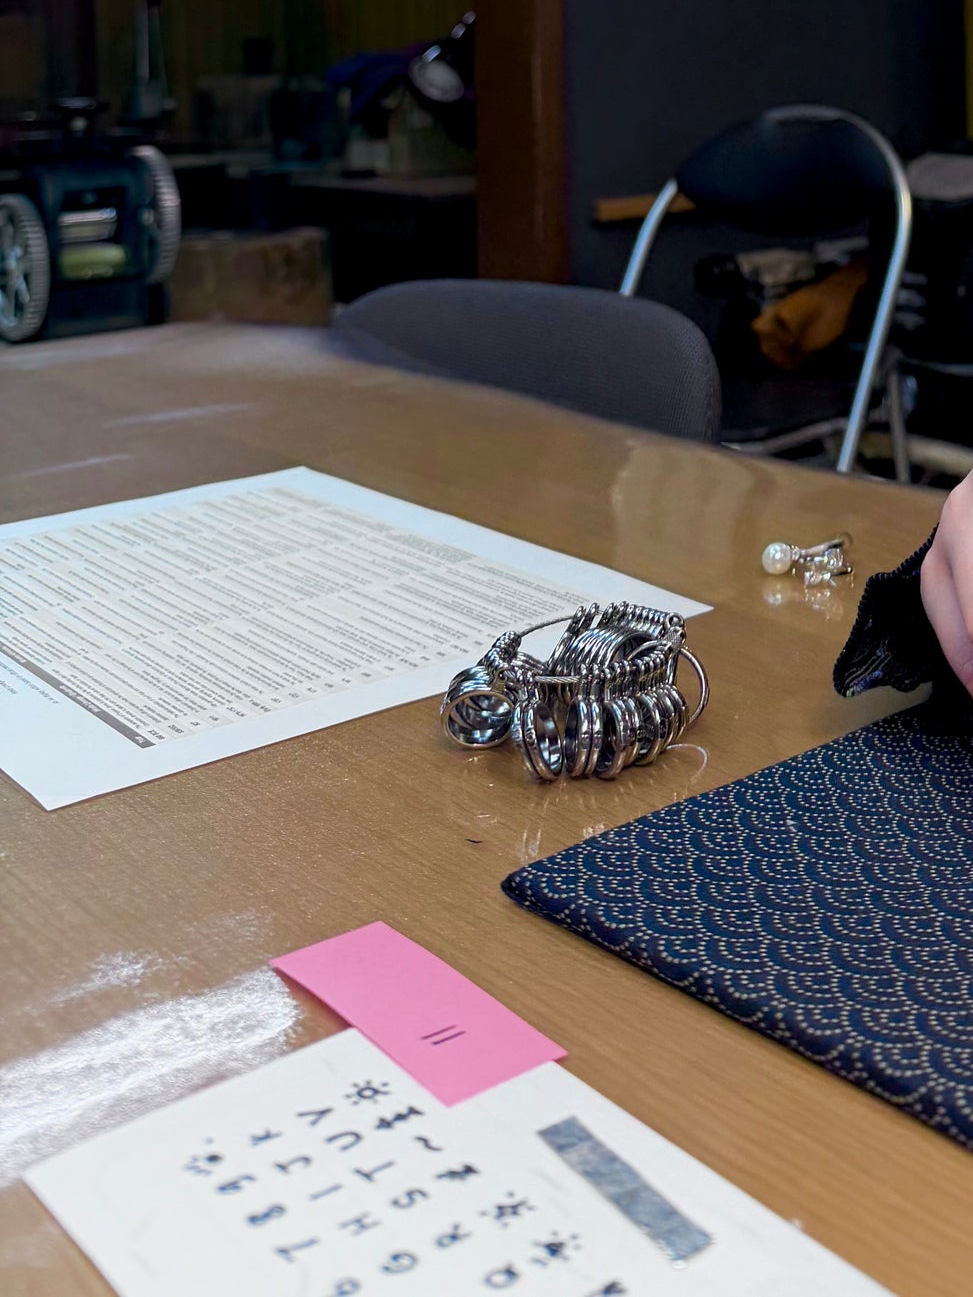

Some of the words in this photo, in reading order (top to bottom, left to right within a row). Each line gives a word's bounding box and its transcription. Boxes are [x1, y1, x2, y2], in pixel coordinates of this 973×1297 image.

[324, 1130, 363, 1151] U
[352, 1161, 396, 1181] T
[338, 1212, 381, 1236] H
